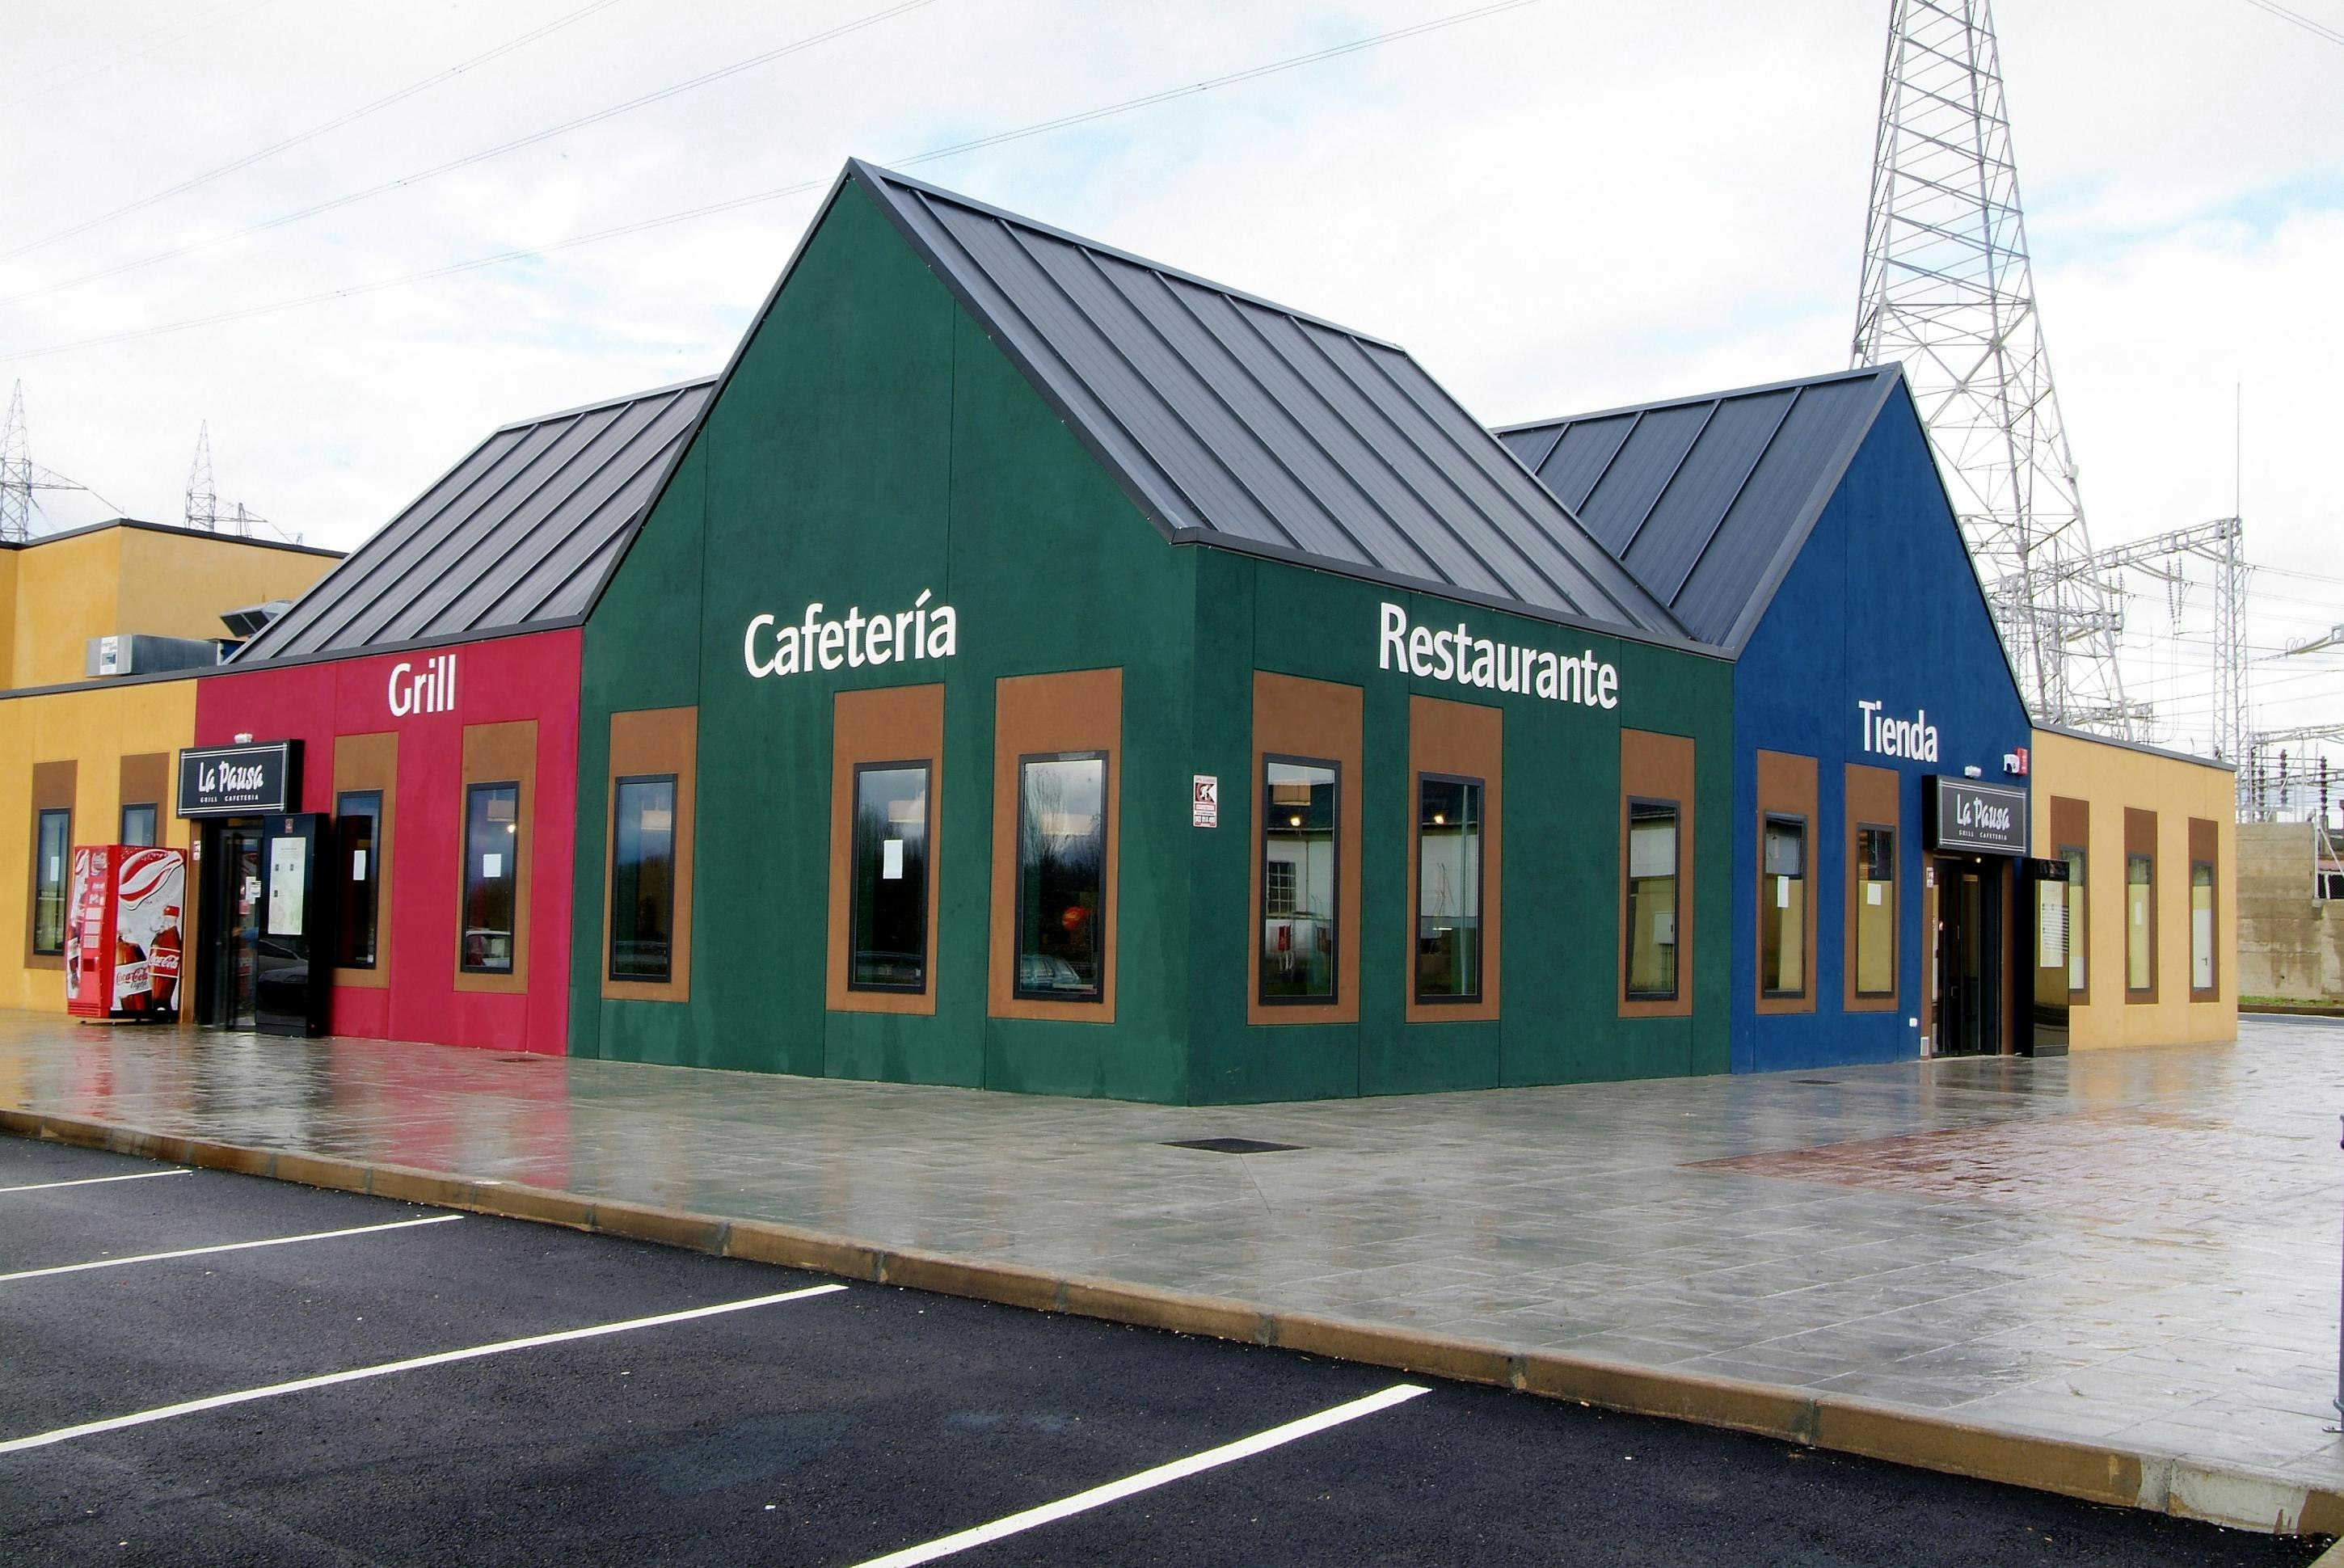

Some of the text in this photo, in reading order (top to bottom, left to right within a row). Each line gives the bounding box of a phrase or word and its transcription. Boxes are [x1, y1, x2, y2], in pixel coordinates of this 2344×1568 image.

[744, 588, 957, 679] Cafetería
[1378, 602, 1618, 710] Restaurante
[389, 654, 456, 717] Grill
[1858, 700, 1938, 763] Tienda
[199, 761, 263, 793] La Pausa
[1957, 794, 2010, 830] La Pausa
[1958, 829, 1974, 837] GRILL
[116, 967, 149, 985] Coca-Cola
[149, 953, 179, 970] Coca-Cola
